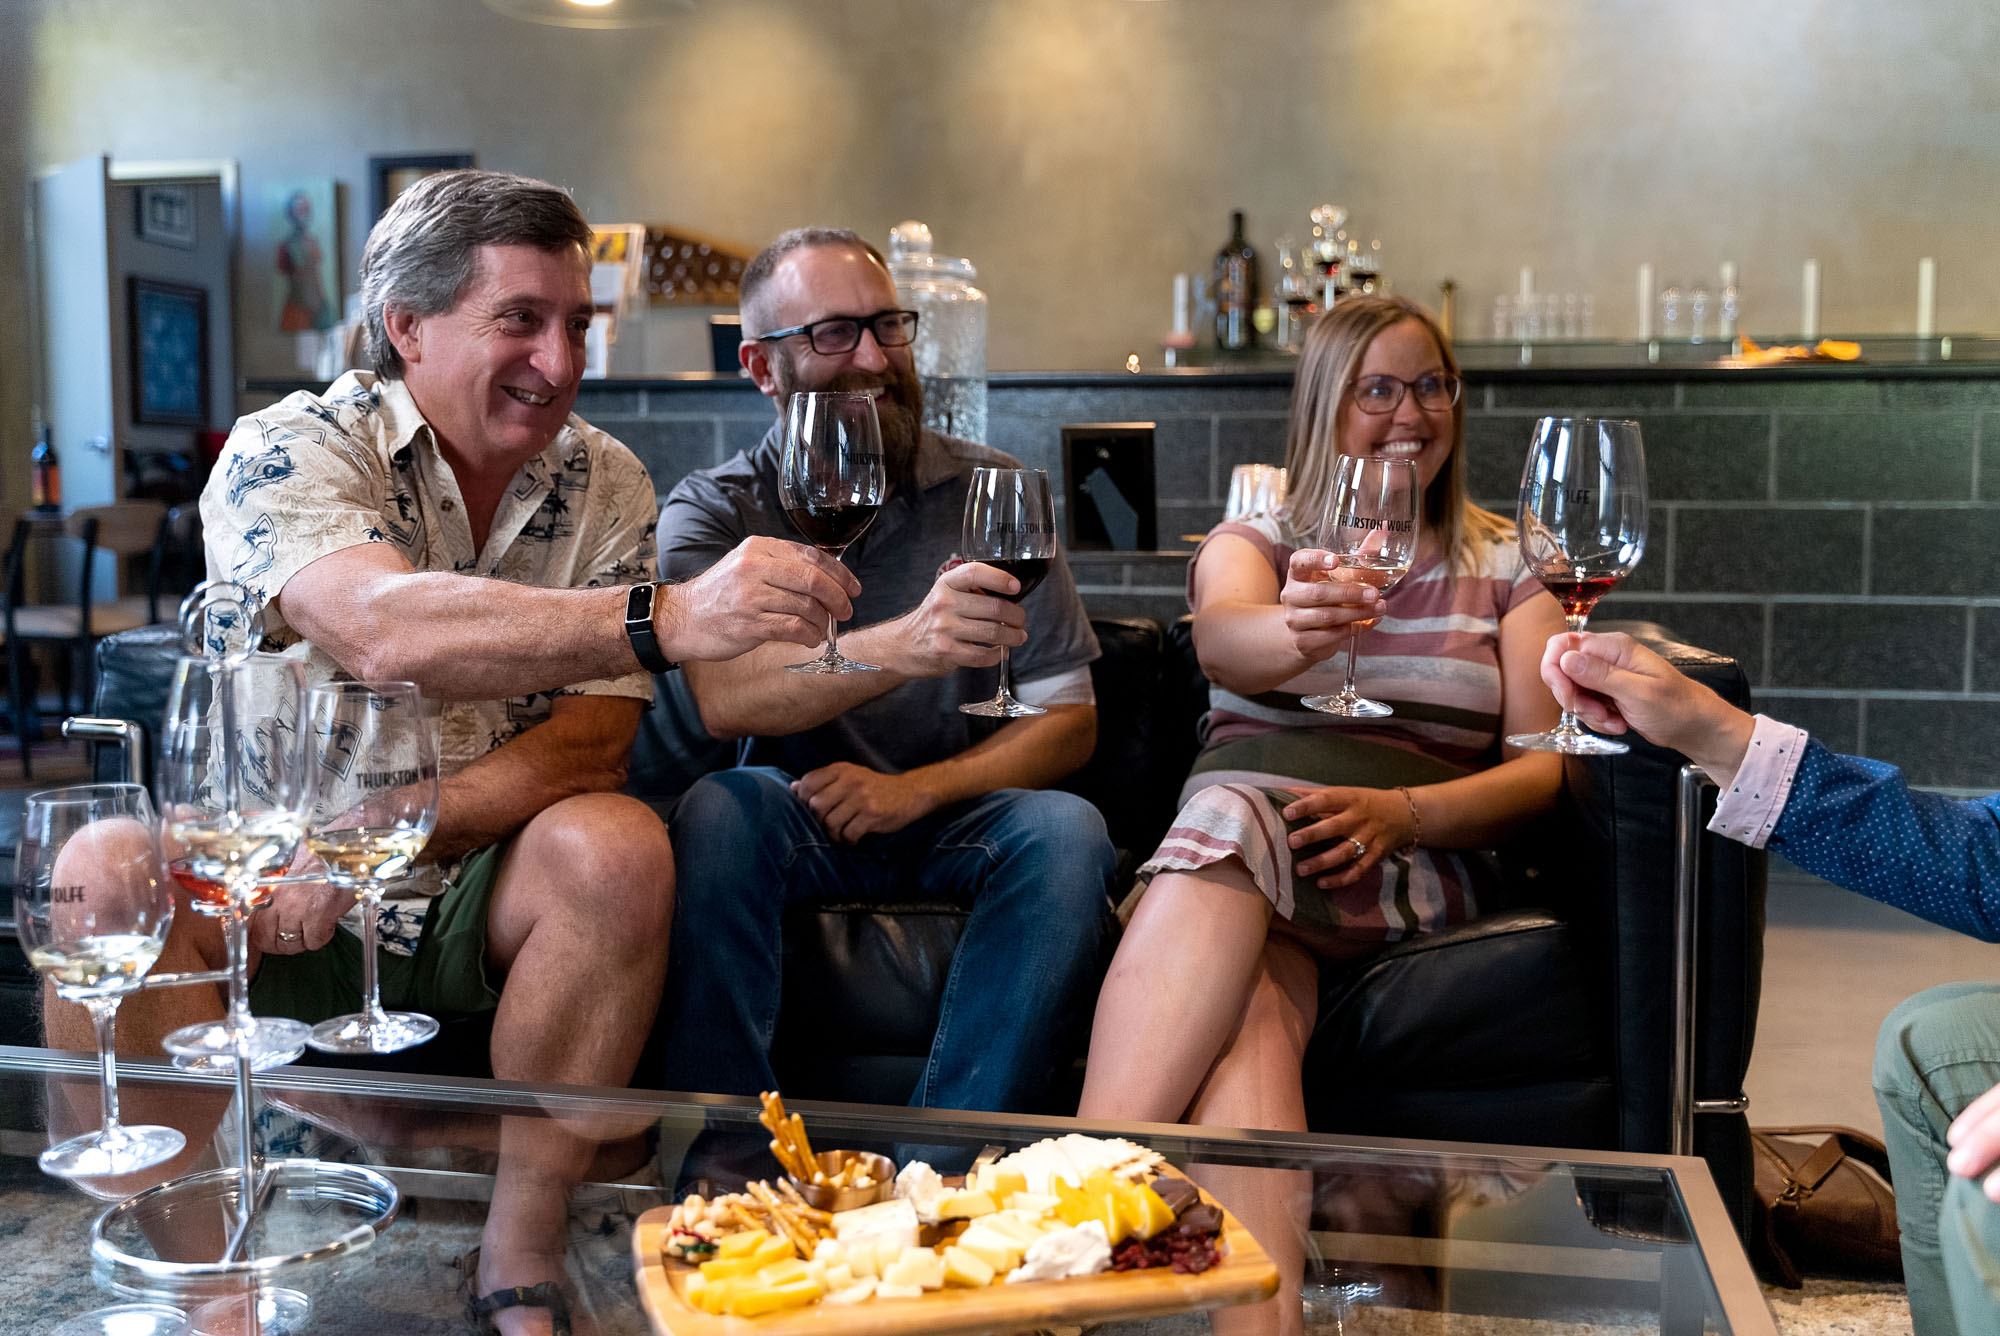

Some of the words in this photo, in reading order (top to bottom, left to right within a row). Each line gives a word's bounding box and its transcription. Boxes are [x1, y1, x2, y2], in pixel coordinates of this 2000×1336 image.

[1338, 514, 1383, 531] THURSTON
[1387, 519, 1413, 532] WOLFE
[356, 767, 419, 789] THURSTON
